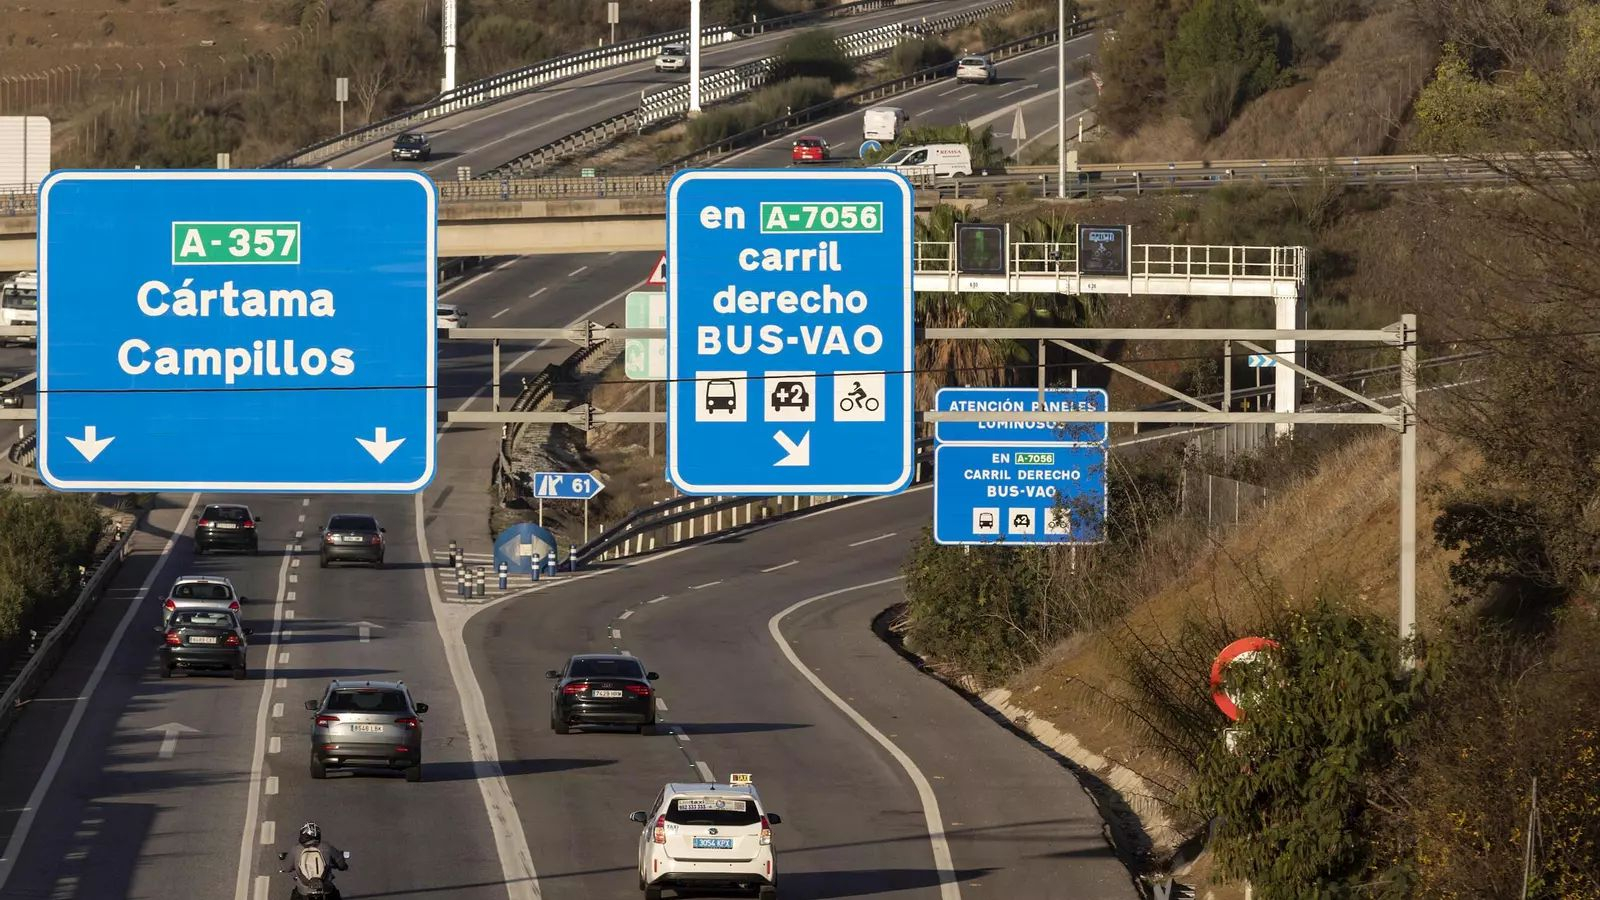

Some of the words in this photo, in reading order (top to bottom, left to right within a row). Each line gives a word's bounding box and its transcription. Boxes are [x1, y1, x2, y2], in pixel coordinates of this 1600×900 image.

[700, 206, 744, 229] en
[766, 206, 877, 229] A-7056
[180, 228, 296, 257] A-357
[739, 241, 841, 271] carril
[138, 278, 336, 317] Cártama
[714, 285, 867, 313] derecho
[697, 325, 883, 354] BUS-VAO
[118, 339, 355, 385] Campillos
[777, 385, 802, 403] +2
[950, 399, 1023, 411] ATENCIÓN
[992, 453, 1010, 463] EN
[1017, 454, 1052, 463] A-7056
[572, 478, 590, 493] 61
[964, 469, 1011, 480] CARRIL
[1018, 469, 1081, 480] DERECHO
[987, 485, 1056, 498] BUS-VAO
